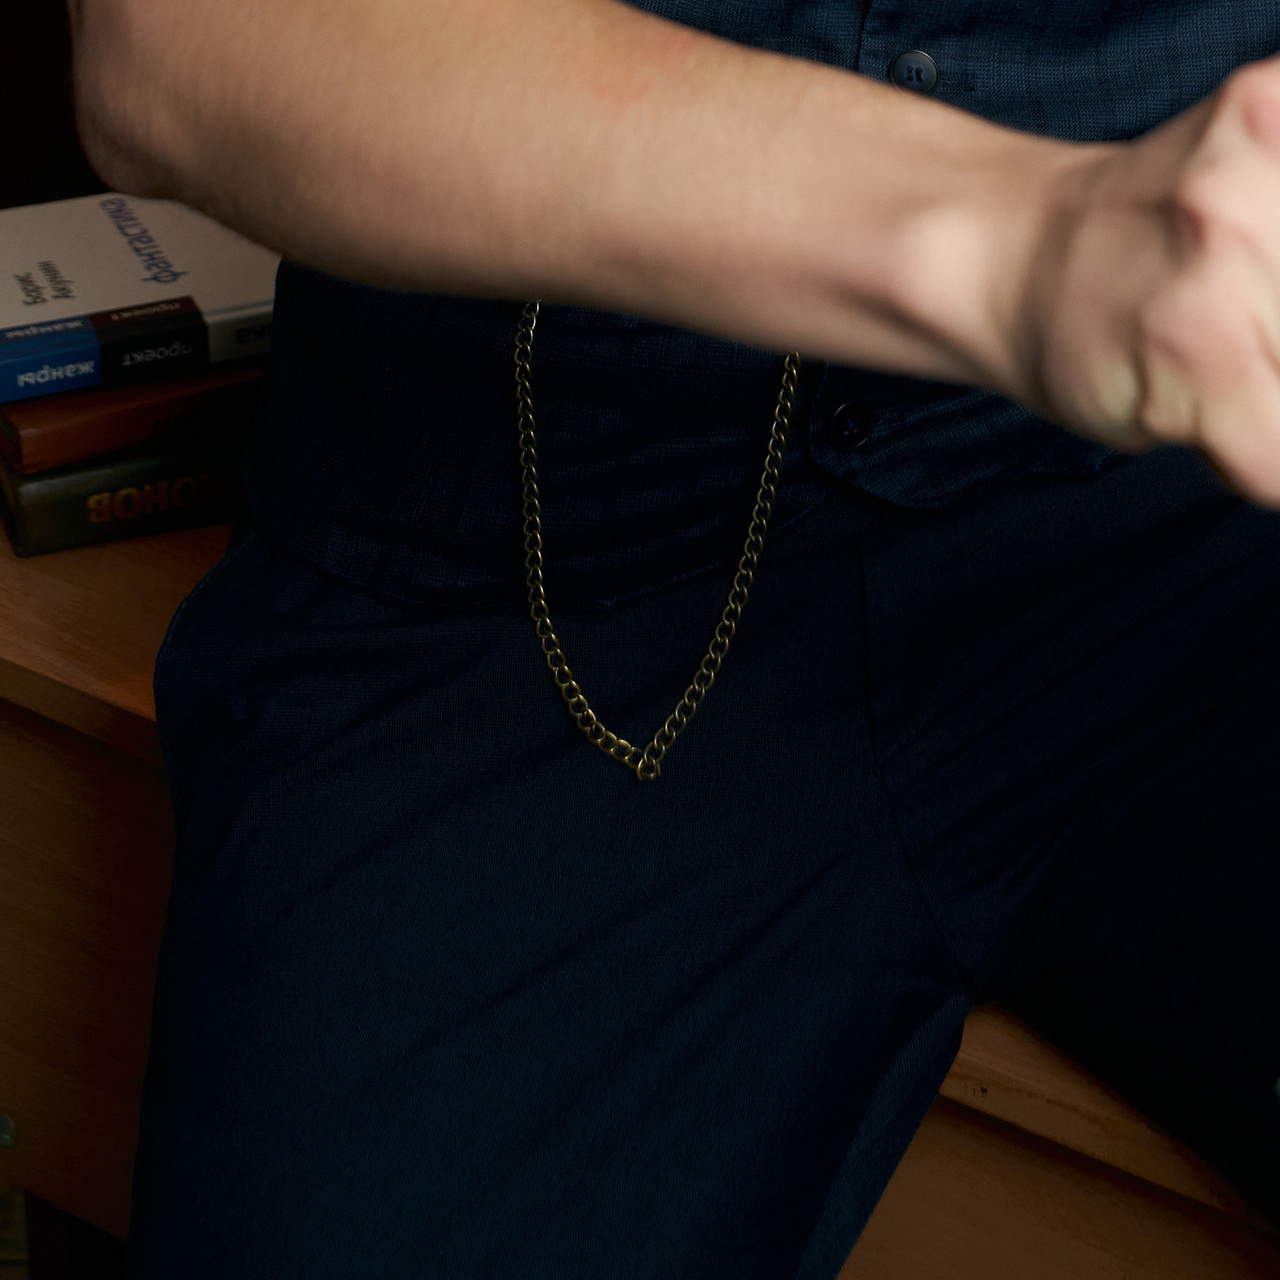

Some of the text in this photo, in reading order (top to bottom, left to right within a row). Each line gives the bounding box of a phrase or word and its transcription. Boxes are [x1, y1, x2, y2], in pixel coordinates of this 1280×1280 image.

[100, 197, 188, 283] фантастика
[5, 319, 84, 339] жанры
[121, 341, 193, 367] проект
[17, 360, 95, 387] жанры
